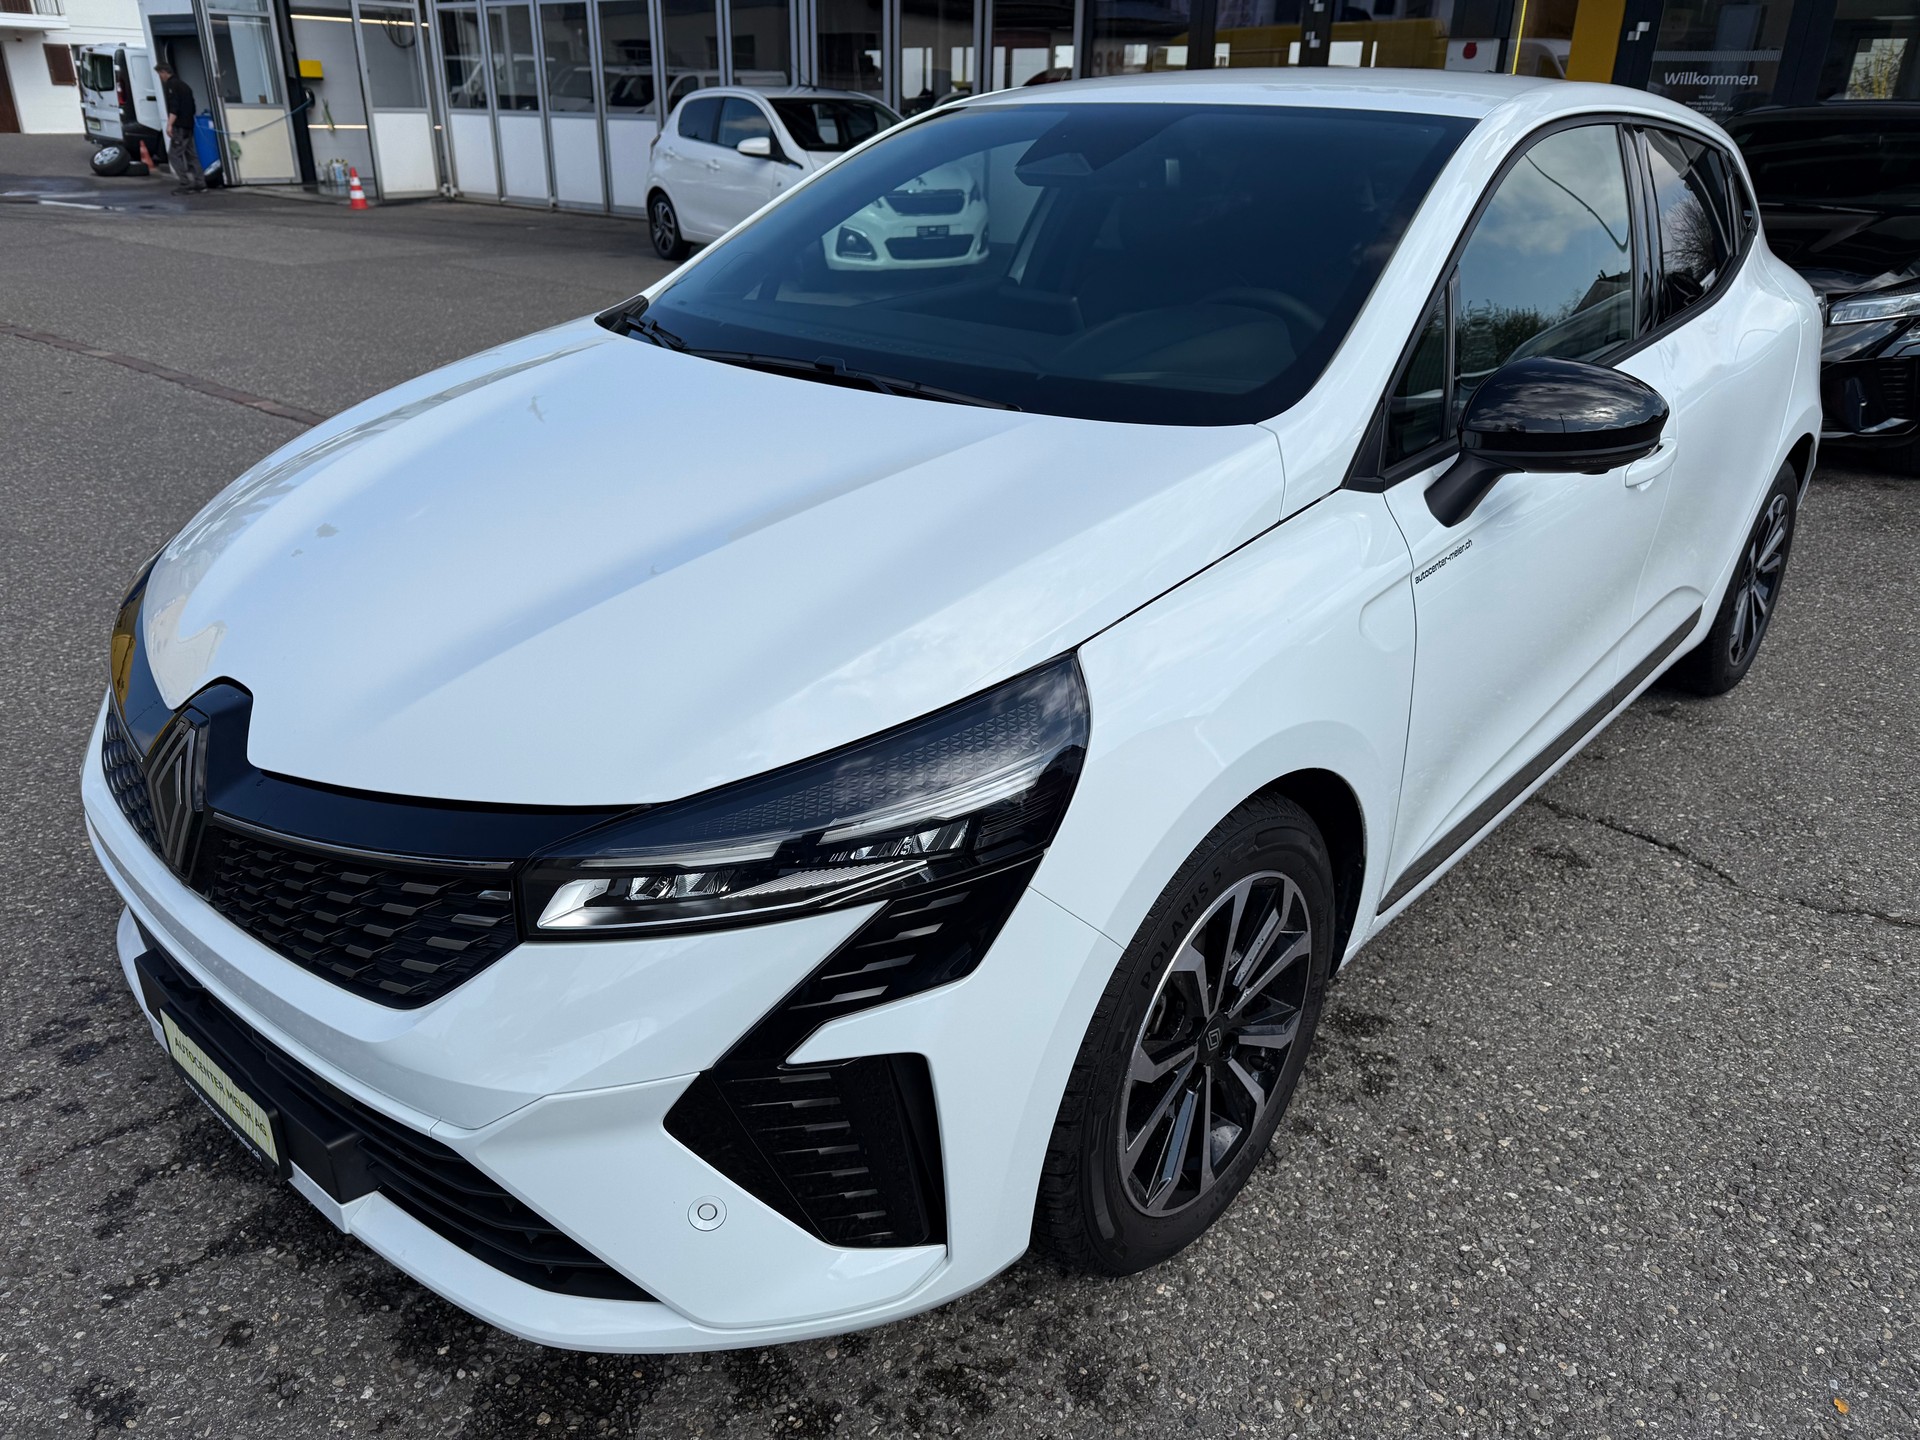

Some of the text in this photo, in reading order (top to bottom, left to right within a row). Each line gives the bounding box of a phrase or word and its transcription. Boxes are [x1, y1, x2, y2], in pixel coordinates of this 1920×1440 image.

[1664, 72, 1759, 86] Willkommen
[1414, 538, 1473, 585] autocenter-meier.ch
[1140, 866, 1222, 990] POLARIS 5
[175, 1038, 268, 1136] AUTOCENTER MEIER AG
